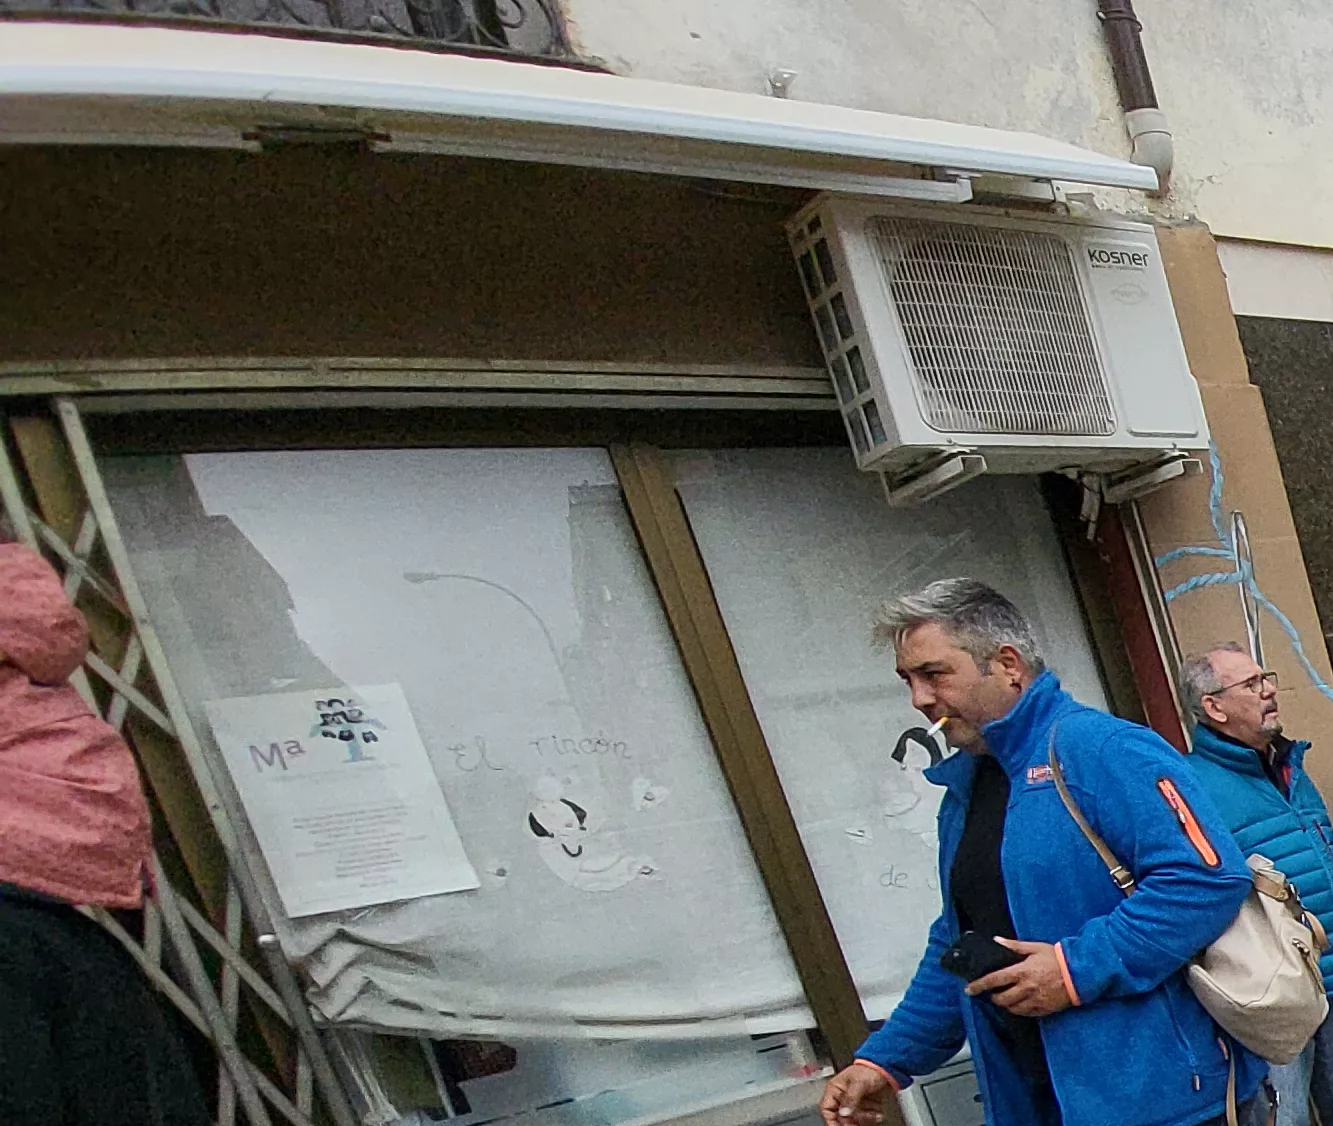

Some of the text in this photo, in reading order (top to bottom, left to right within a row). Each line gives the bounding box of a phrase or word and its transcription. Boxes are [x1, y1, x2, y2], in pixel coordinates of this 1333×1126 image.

[449, 731, 633, 772] El rincón
[880, 864, 909, 889] de
